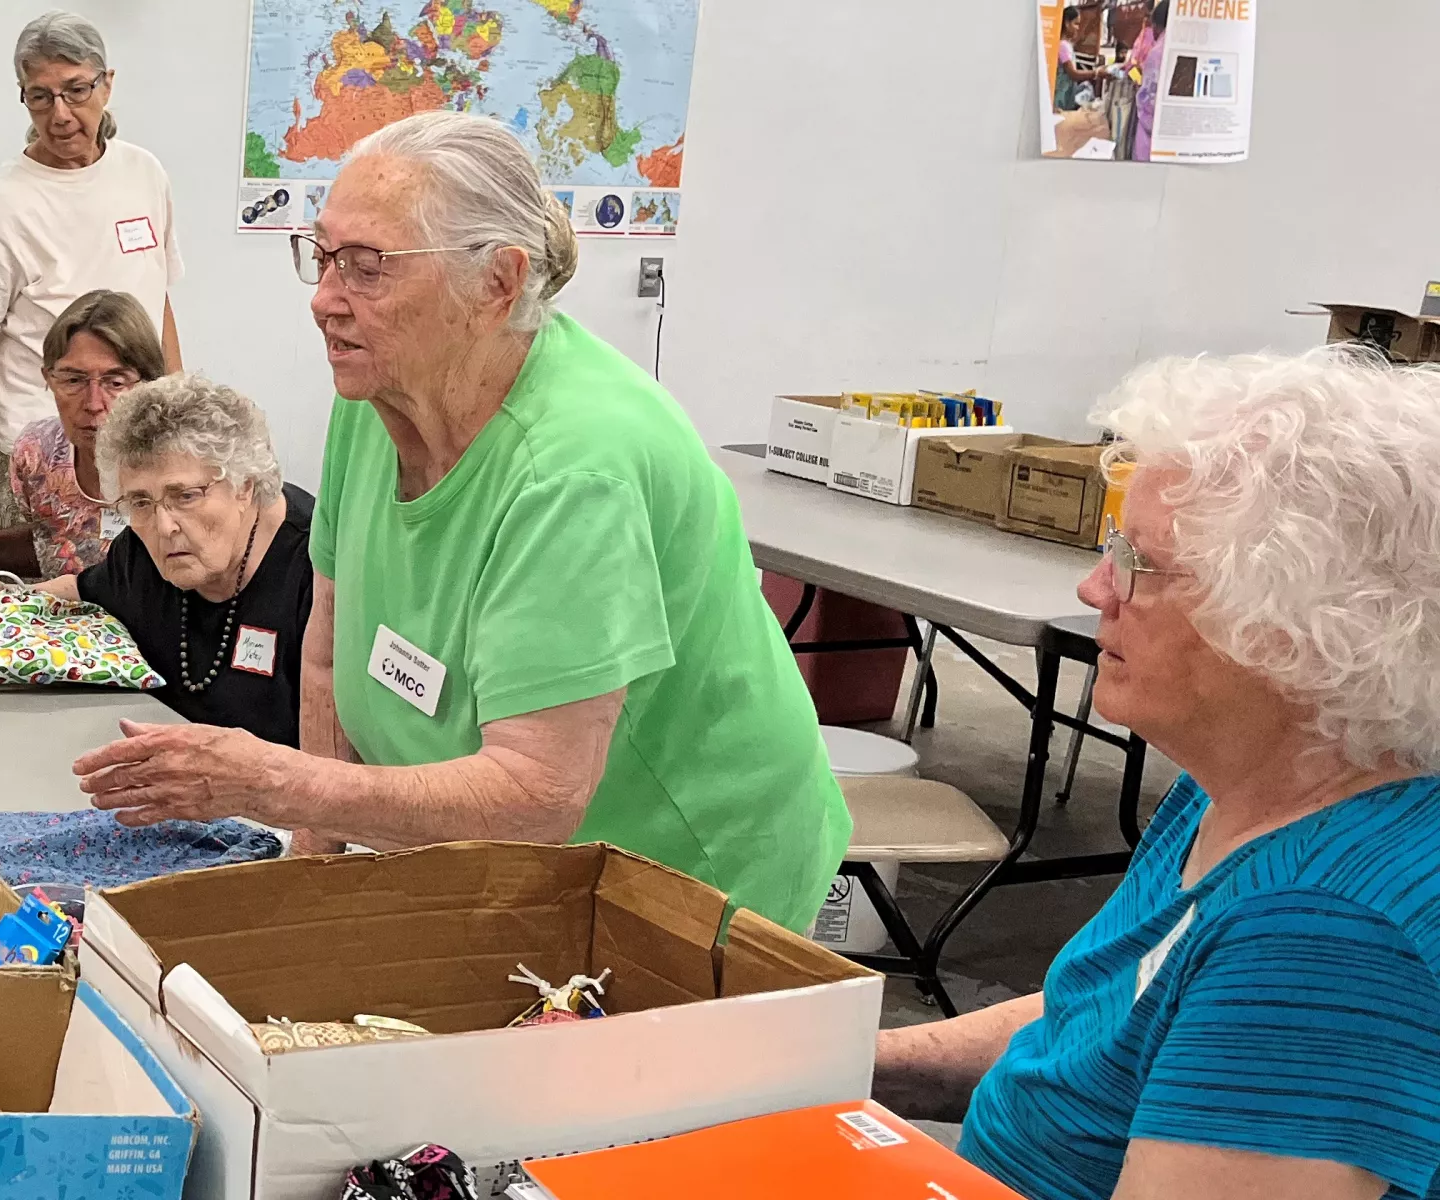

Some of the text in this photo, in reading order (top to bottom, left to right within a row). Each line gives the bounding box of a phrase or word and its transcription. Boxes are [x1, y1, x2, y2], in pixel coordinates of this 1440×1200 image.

[1175, 0, 1249, 20] HYGIENE
[389, 641, 413, 660] Johanna
[394, 668, 425, 697] MCC
[53, 923, 69, 944] 12
[111, 1135, 151, 1146] NORCOM,
[109, 1150, 161, 1160] GRIFFIN, GA
[106, 1164, 163, 1174] MADE IN USA
